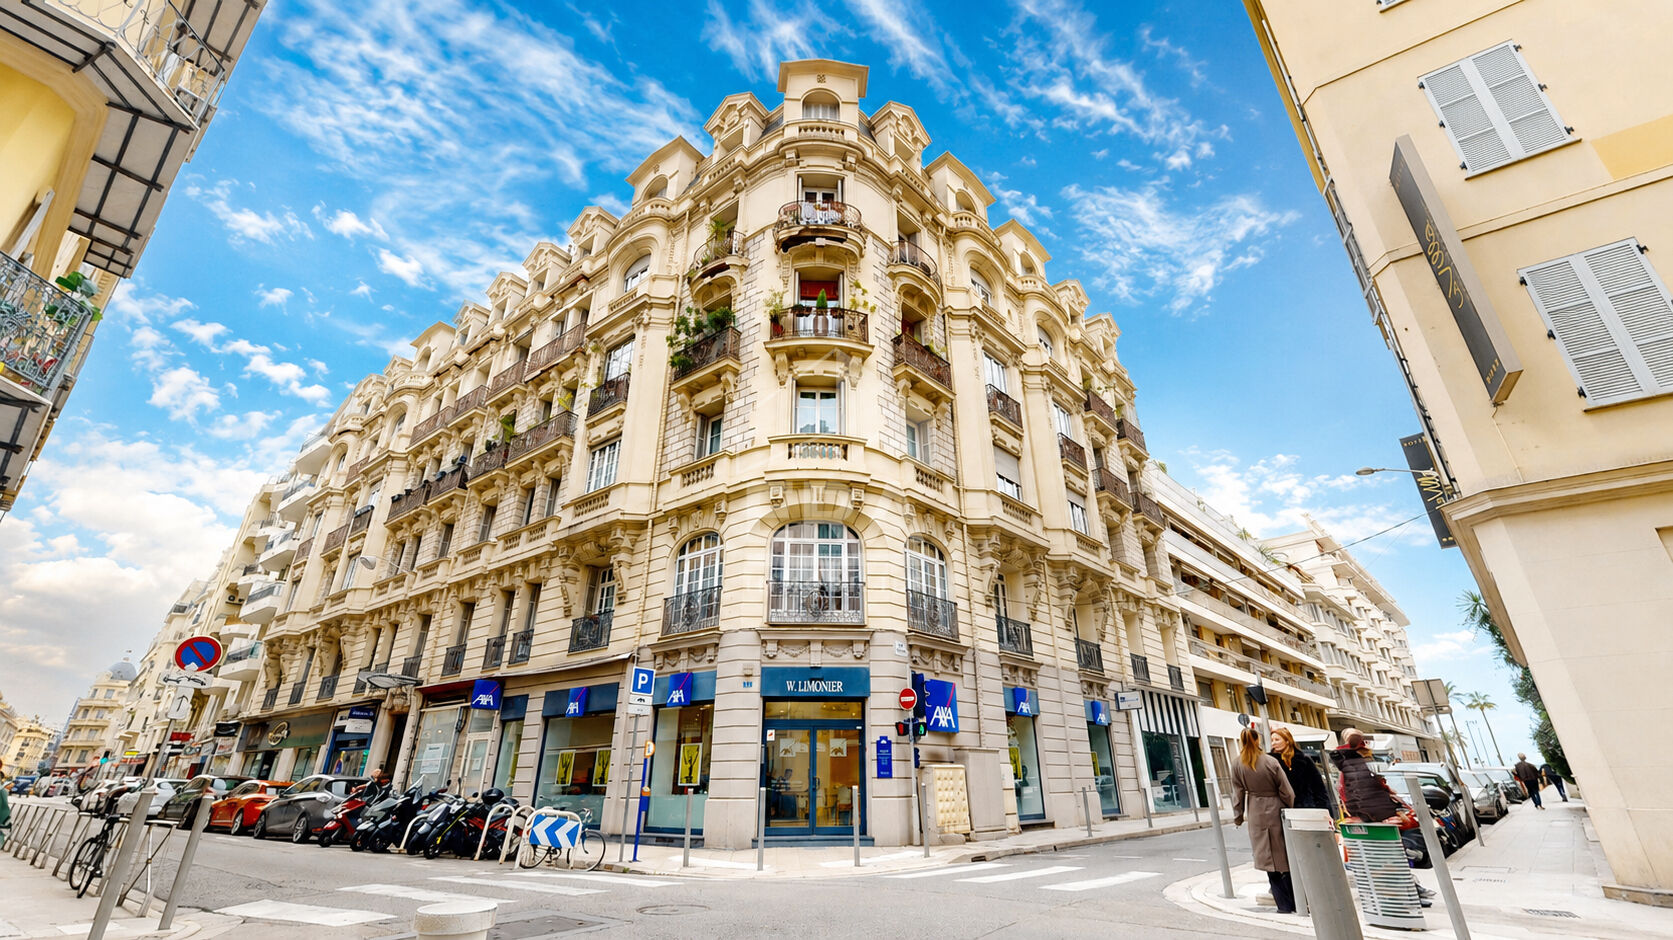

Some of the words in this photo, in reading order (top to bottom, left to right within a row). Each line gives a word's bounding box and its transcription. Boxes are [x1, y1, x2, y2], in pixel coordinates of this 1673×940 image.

[637, 673, 648, 690] P
[786, 680, 797, 692] W.
[798, 680, 843, 692] LIMONIER
[472, 694, 493, 706] AXA
[667, 689, 685, 703] AXA
[929, 705, 956, 728] AXA
